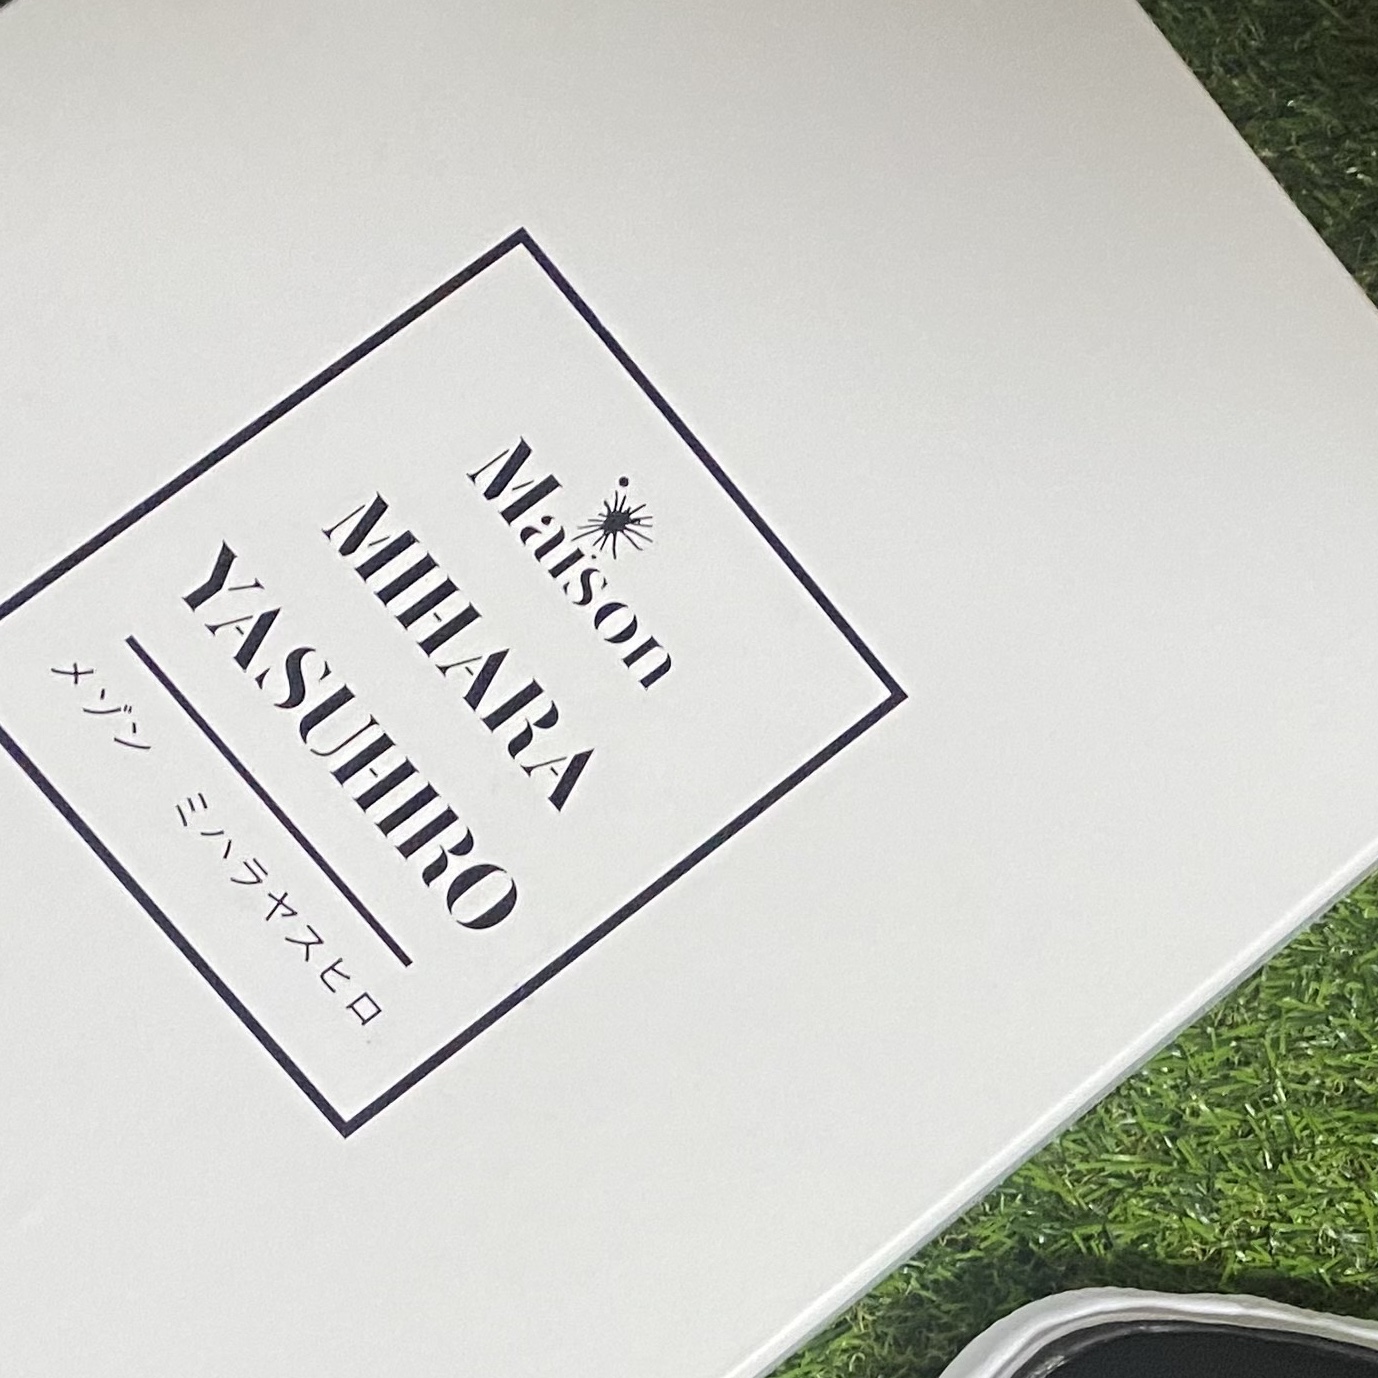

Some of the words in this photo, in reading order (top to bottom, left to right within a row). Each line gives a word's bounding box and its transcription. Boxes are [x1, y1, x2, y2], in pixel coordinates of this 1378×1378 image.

[321, 491, 595, 813] MIHARA
[466, 436, 673, 691] Maison
[181, 539, 518, 931] YASUHIRO
